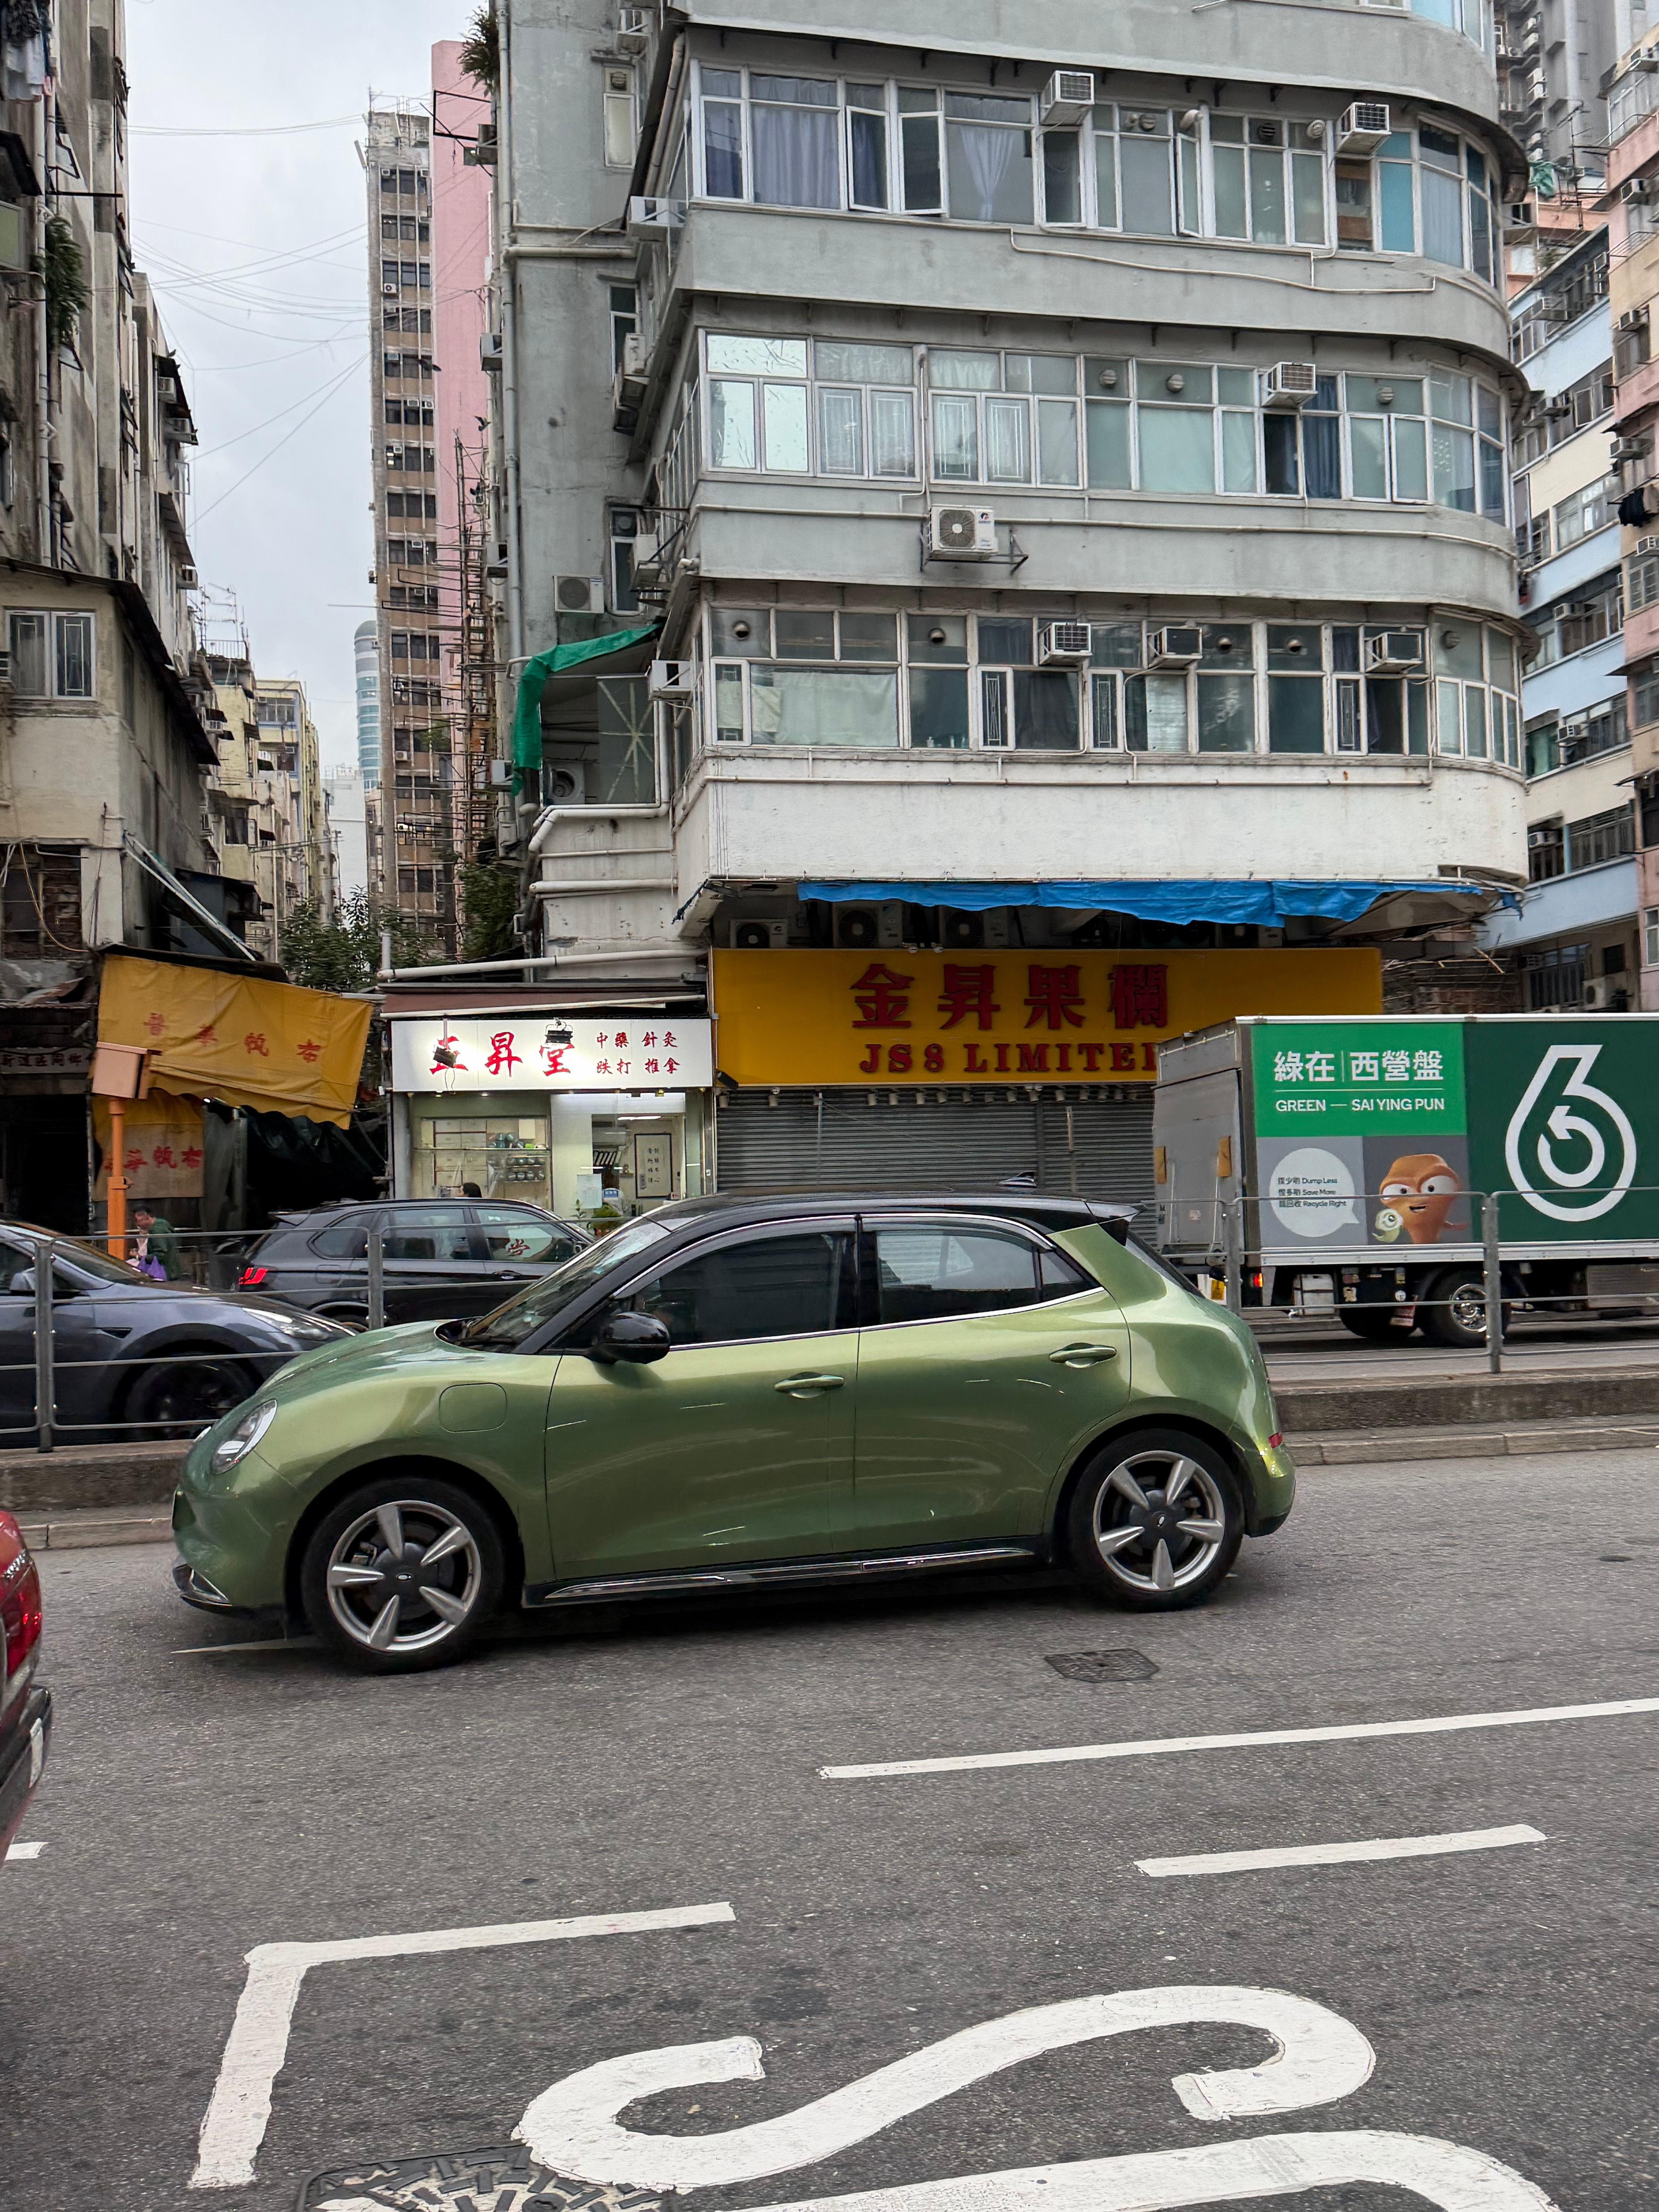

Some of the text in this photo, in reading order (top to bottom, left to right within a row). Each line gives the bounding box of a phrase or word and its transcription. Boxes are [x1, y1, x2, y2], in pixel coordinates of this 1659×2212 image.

[850, 963, 1169, 1030] 金昇果欄
[597, 1031, 678, 1049] 中藥 針灸
[596, 1057, 680, 1074] 跌打 推拿
[859, 1043, 945, 1073] JS8
[1274, 1049, 1444, 1082] 綠在 西營盤
[1275, 1098, 1444, 1111] GREEN SAI YING PUN
